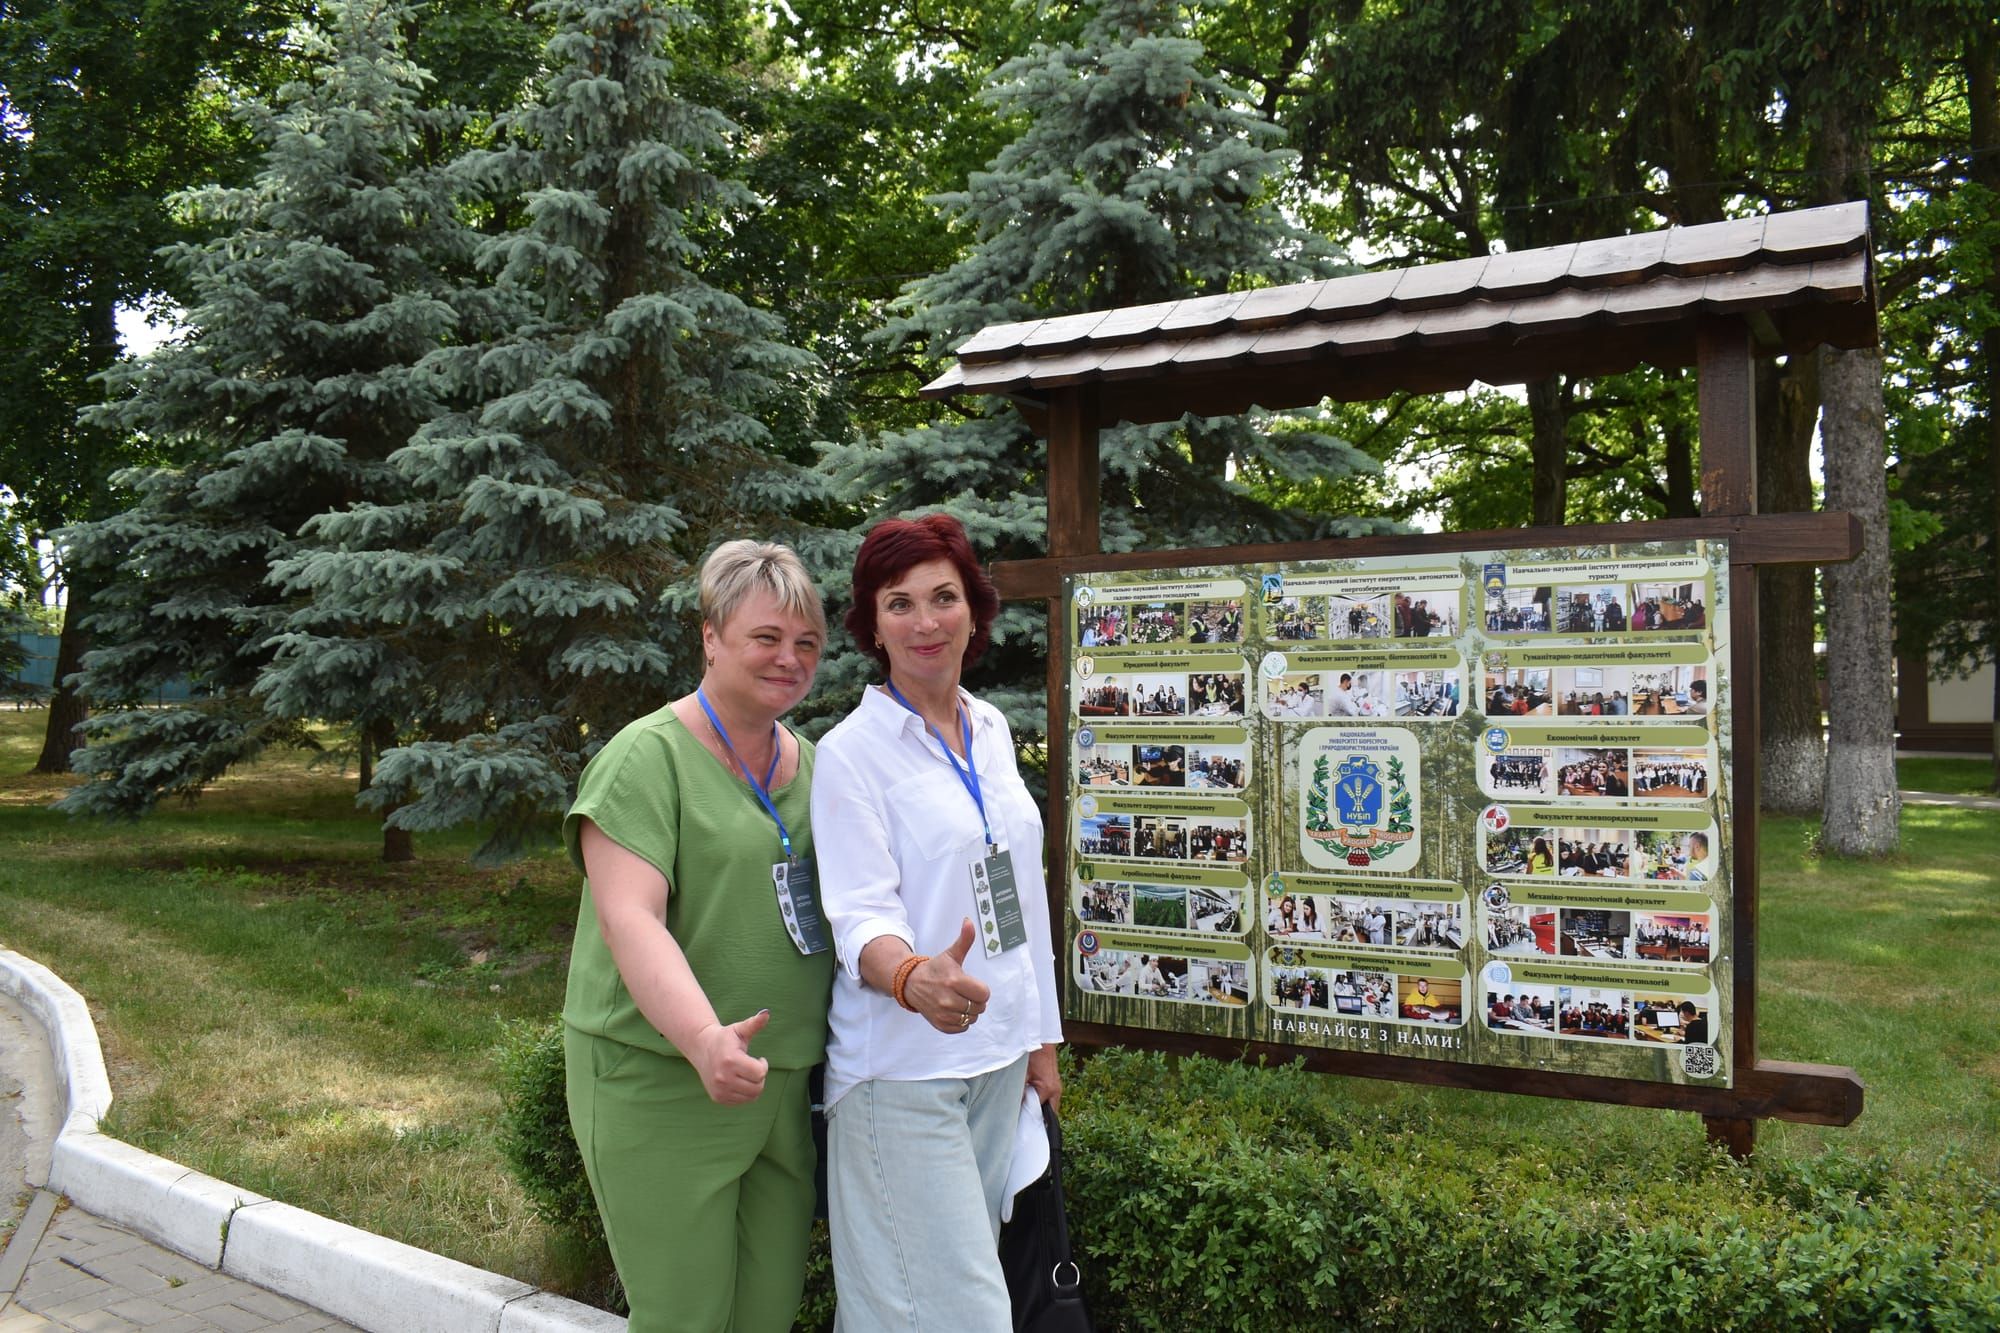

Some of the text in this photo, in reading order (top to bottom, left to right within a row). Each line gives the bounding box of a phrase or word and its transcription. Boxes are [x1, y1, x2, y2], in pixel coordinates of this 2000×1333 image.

[1272, 1019, 1461, 1049] НАВЧАЙСЯ З НАМИ!
